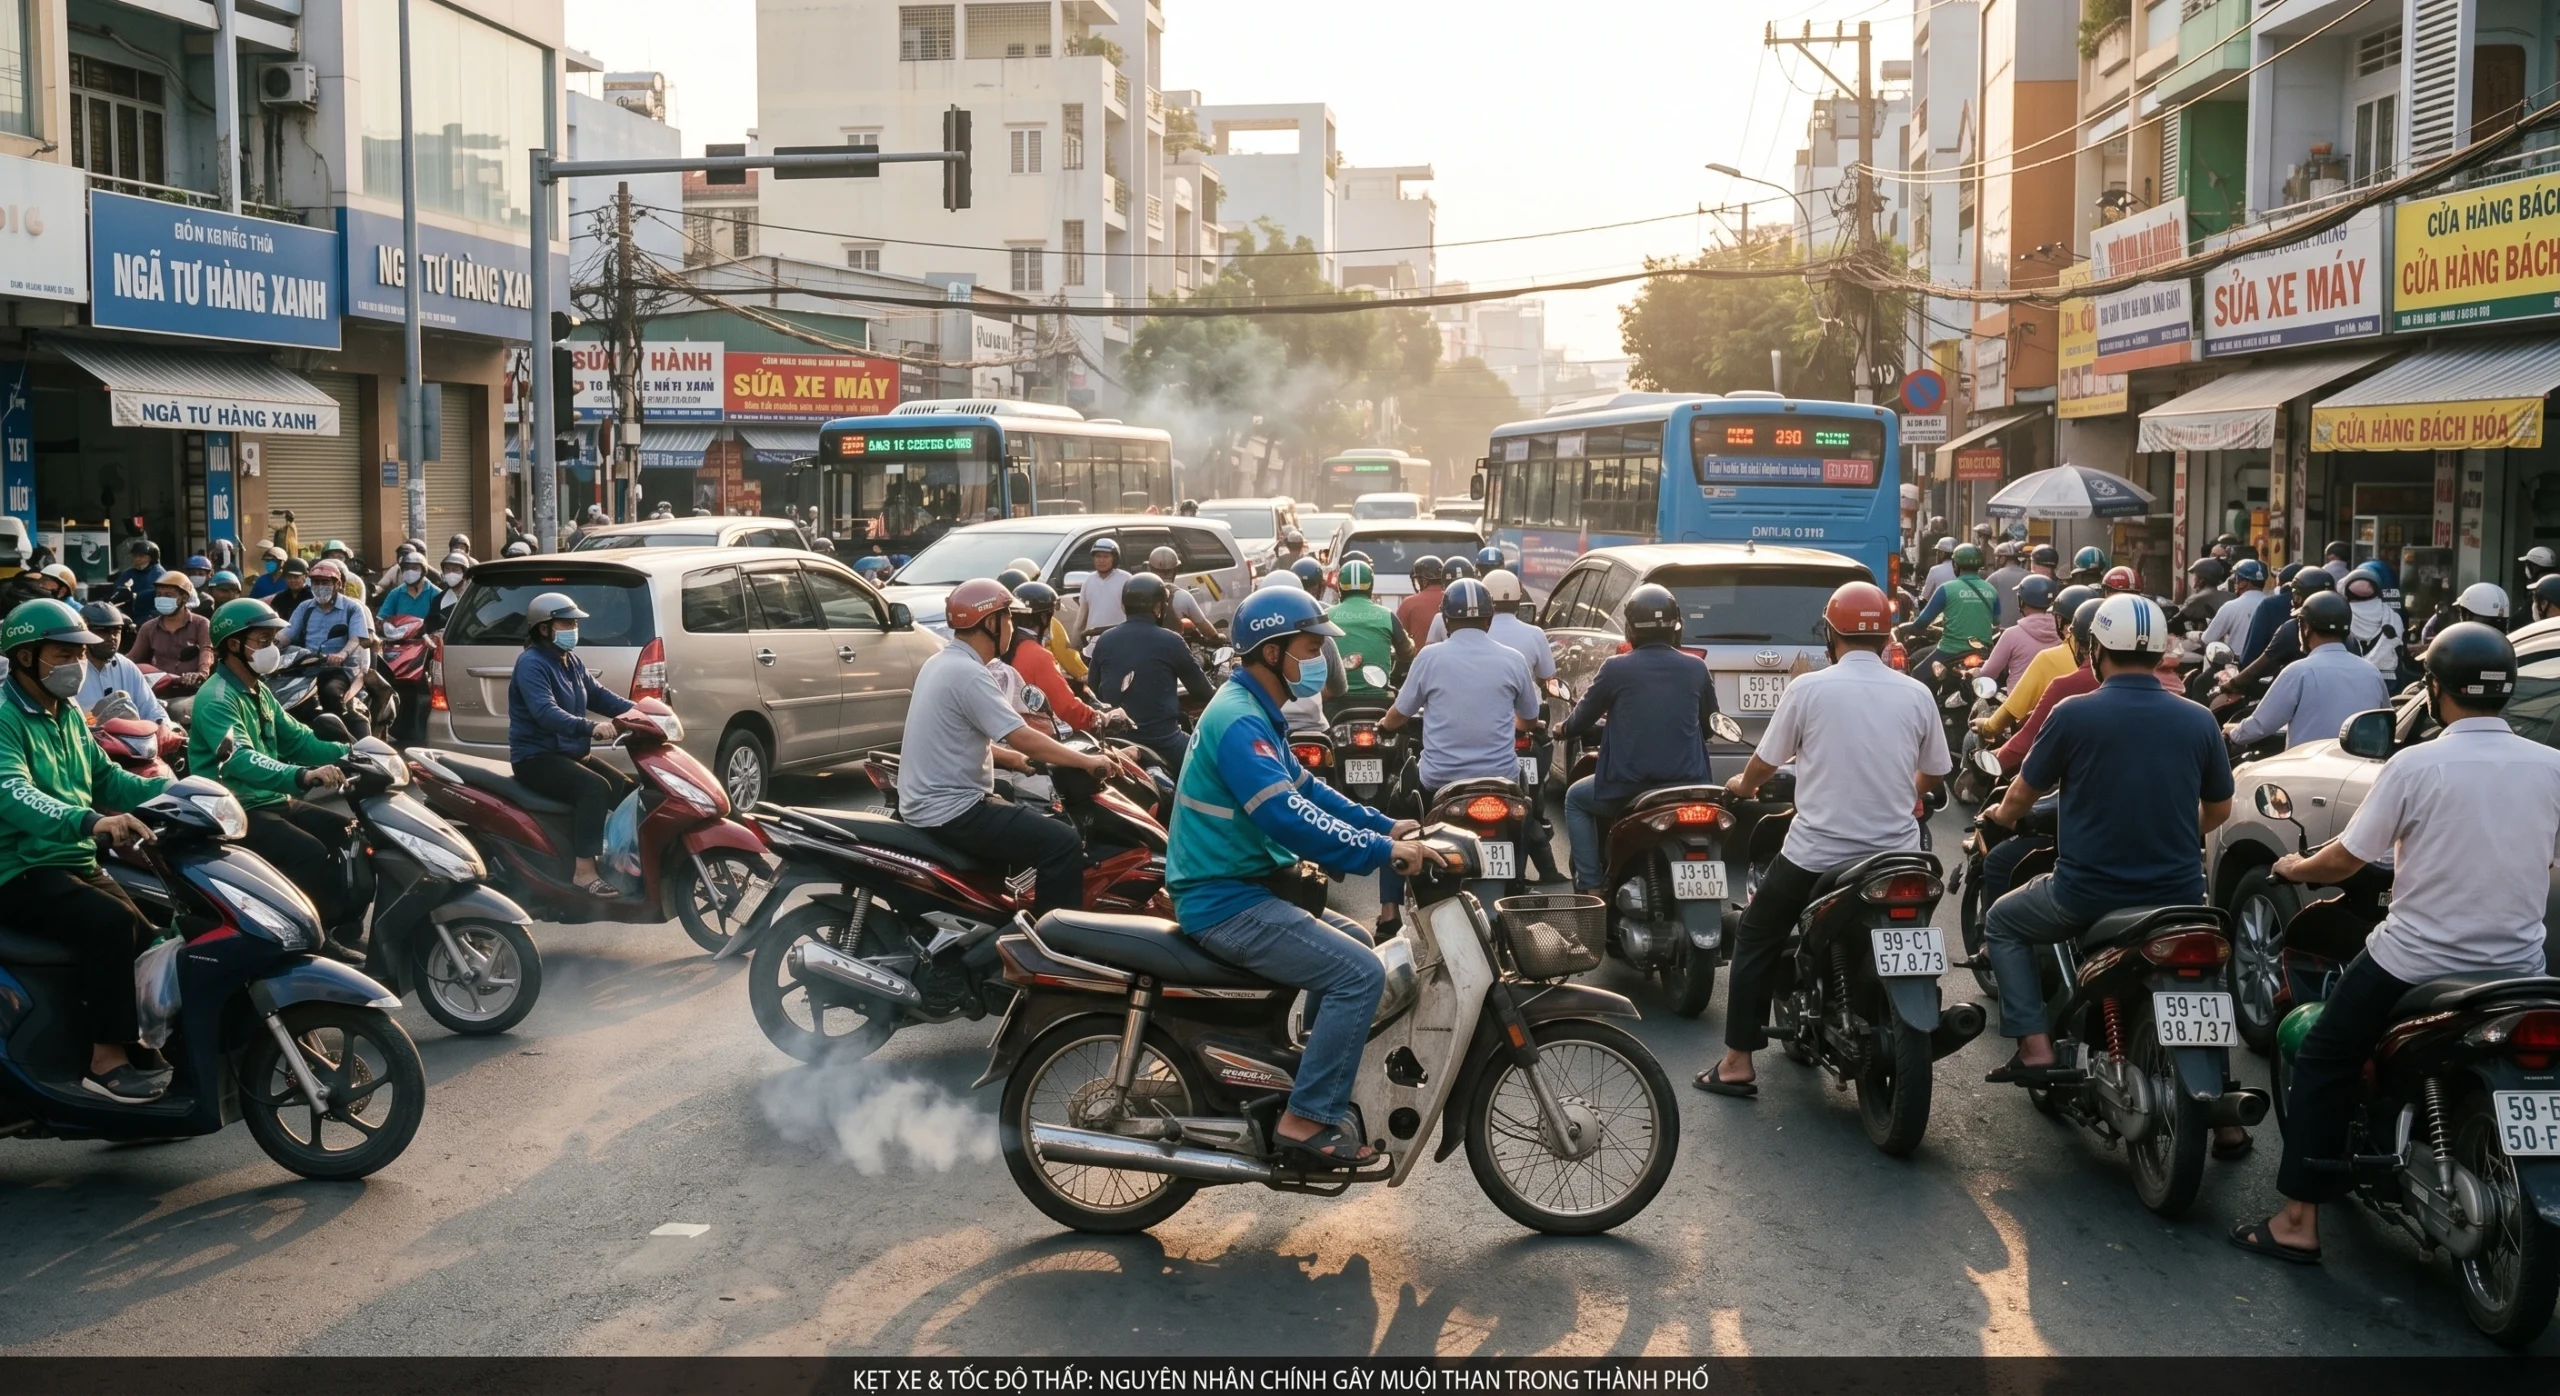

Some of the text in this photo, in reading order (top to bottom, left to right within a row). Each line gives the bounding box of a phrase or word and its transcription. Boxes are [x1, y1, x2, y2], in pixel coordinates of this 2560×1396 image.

[2427, 201, 2460, 237] CỬA
[2466, 196, 2513, 230] HÀNG
[379, 245, 532, 310] NG TƯ HÀNG XAN
[2403, 232, 2560, 296] CỬA HÀNG BÁCH
[114, 250, 327, 321] NGÃ TƯ HÀNG XANH
[2214, 268, 2260, 327] SỬA
[2267, 272, 2298, 319] XE
[2306, 250, 2366, 313] MÁY
[651, 347, 712, 371] HÀNH
[733, 368, 890, 400] SỬA XE MÁY
[142, 401, 317, 430] NGÃ TƯ HÀNG XANH
[2337, 407, 2509, 443] CỬA HÀNG BÁCH HÓA
[1743, 694, 1780, 708] 875.0
[1880, 952, 1944, 973] 57.8.73
[2166, 996, 2219, 1019] 59-C1
[2162, 1020, 2231, 1043] 38.7.37
